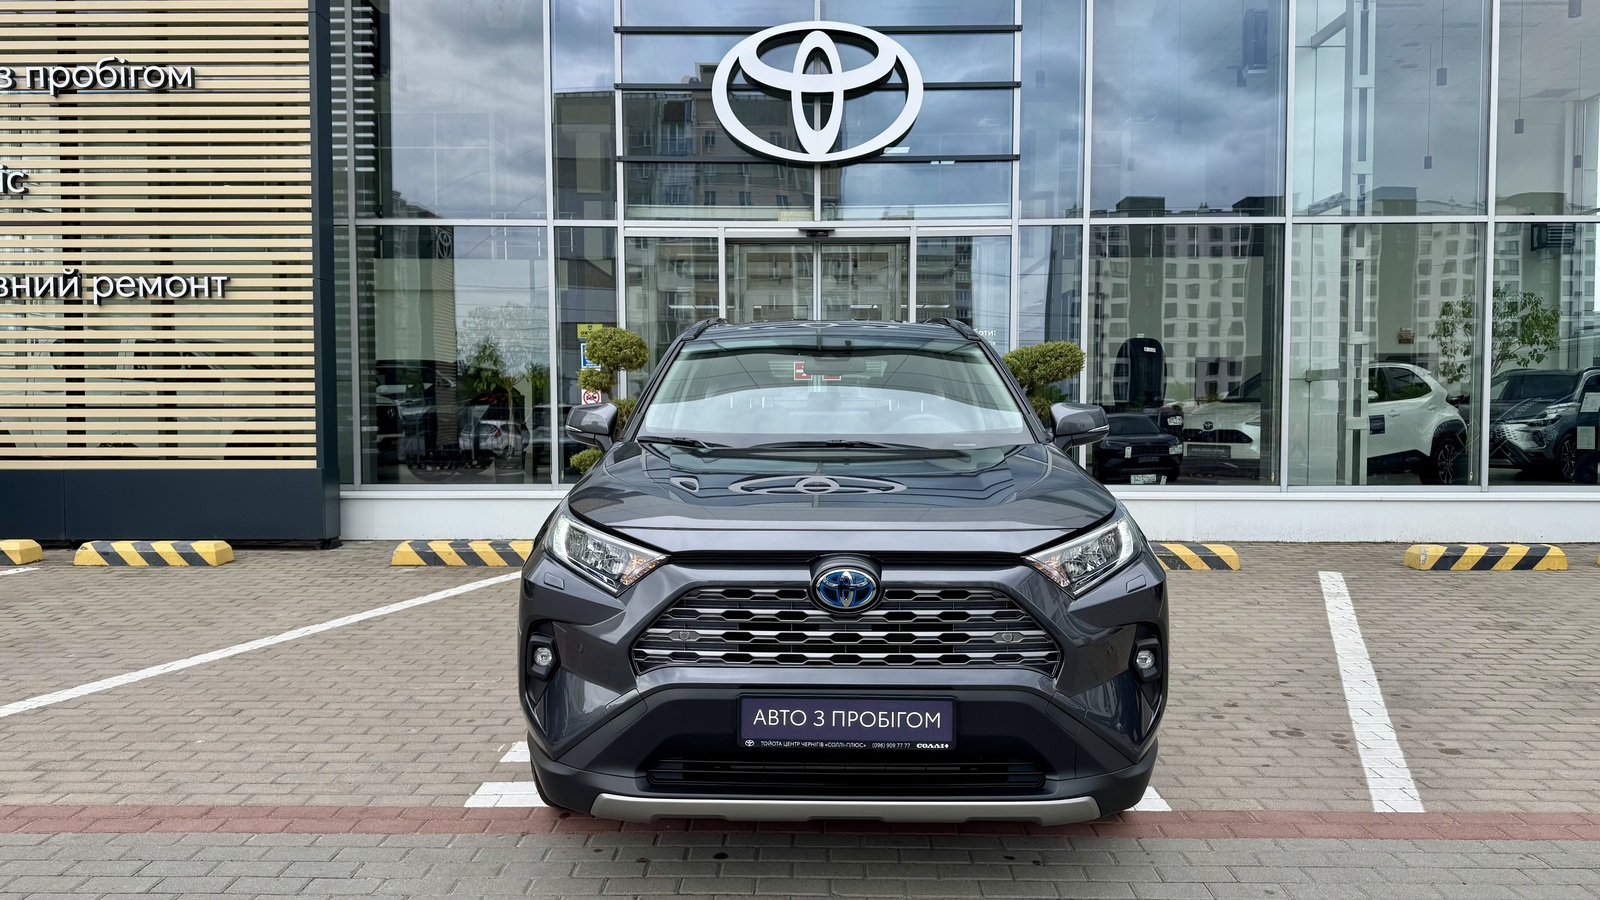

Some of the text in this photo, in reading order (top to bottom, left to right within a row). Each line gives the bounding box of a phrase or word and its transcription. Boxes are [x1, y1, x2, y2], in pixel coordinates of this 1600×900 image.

[26, 57, 194, 97] пробігом
[93, 275, 229, 305] ремонт
[753, 709, 941, 729] АВТО З ПРОБІГОМ
